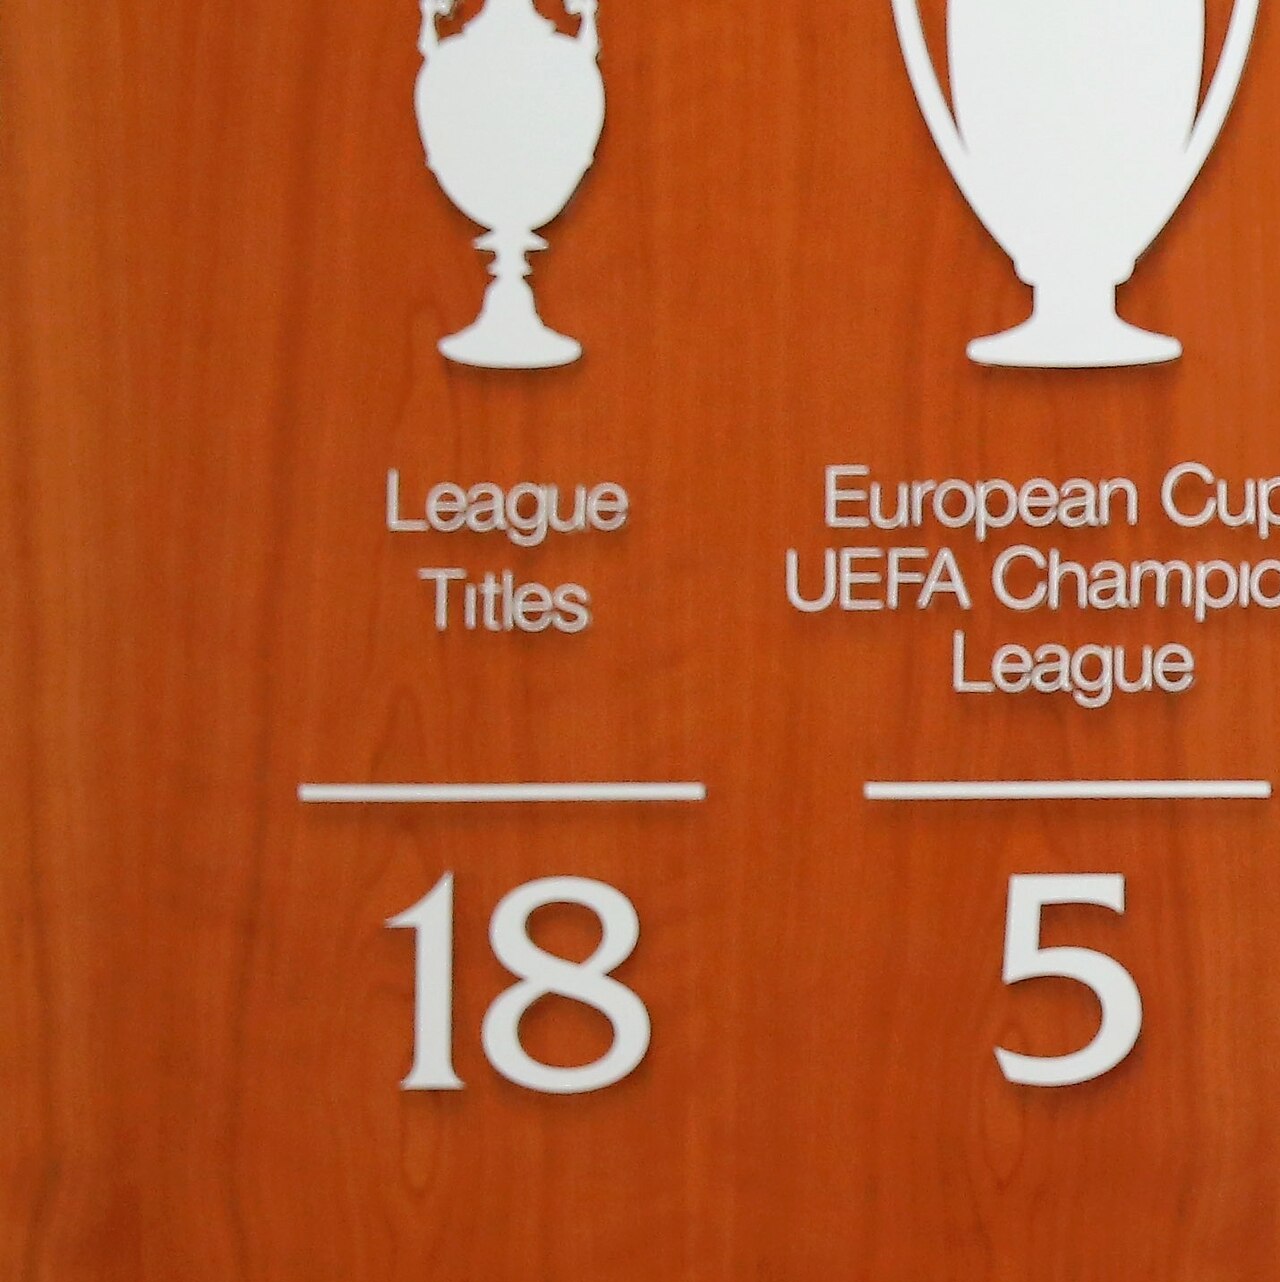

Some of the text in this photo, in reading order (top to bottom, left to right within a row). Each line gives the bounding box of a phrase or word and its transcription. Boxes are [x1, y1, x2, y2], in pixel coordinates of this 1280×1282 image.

[386, 468, 629, 547] League
[824, 464, 1138, 541] European
[418, 567, 590, 633] Titles
[785, 547, 972, 613] UEFA
[952, 630, 1195, 708] League
[385, 871, 651, 1094] 18
[993, 873, 1143, 1087] 5
